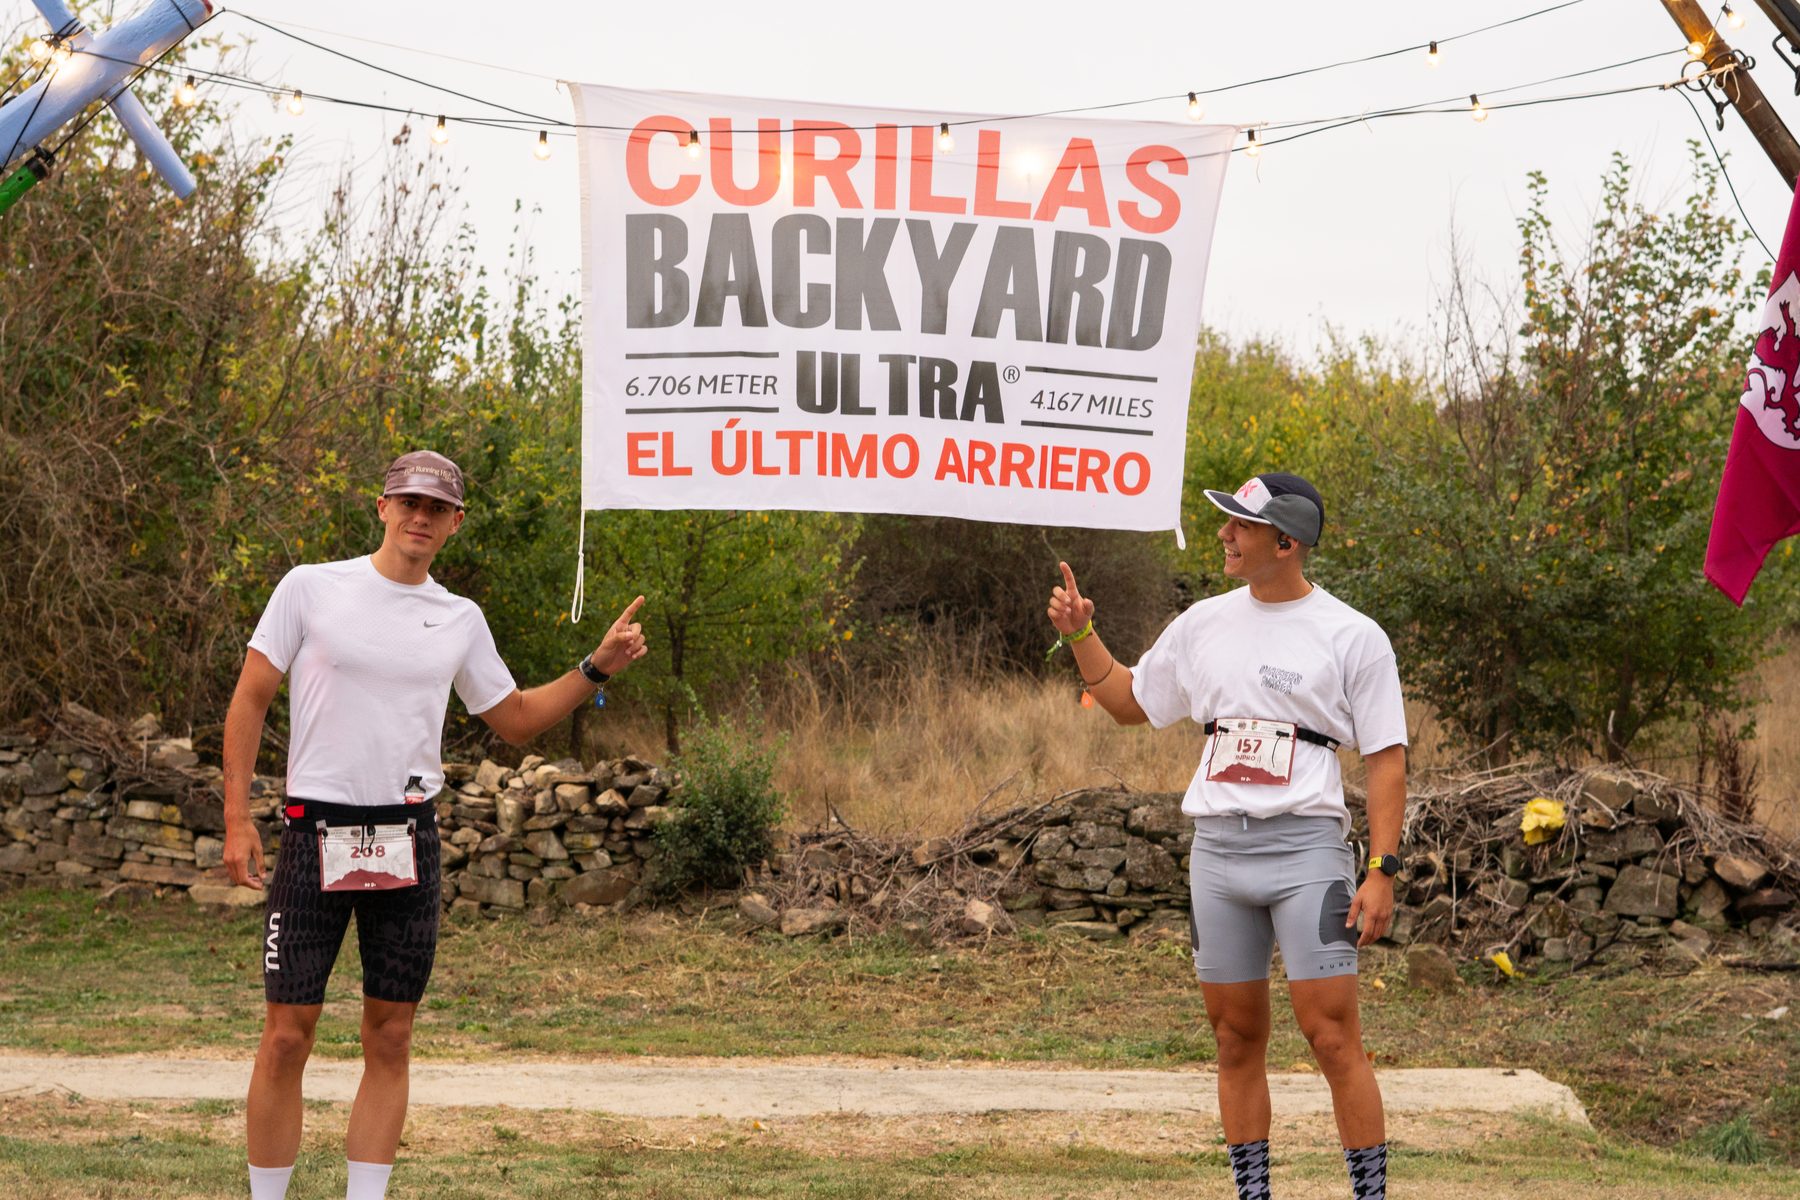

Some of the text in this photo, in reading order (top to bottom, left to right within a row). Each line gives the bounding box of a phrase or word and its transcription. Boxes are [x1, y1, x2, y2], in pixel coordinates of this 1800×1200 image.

[625, 114, 1190, 235] CURILLAS
[625, 212, 1173, 351] BACKYARD
[626, 373, 778, 397] 6.706 METER
[1086, 394, 1154, 419] MILES
[626, 417, 1152, 496] EL ÚLTIMO ARRIERO
[1237, 739, 1262, 754] 157
[350, 845, 386, 858] 208
[265, 912, 281, 970] UVU
